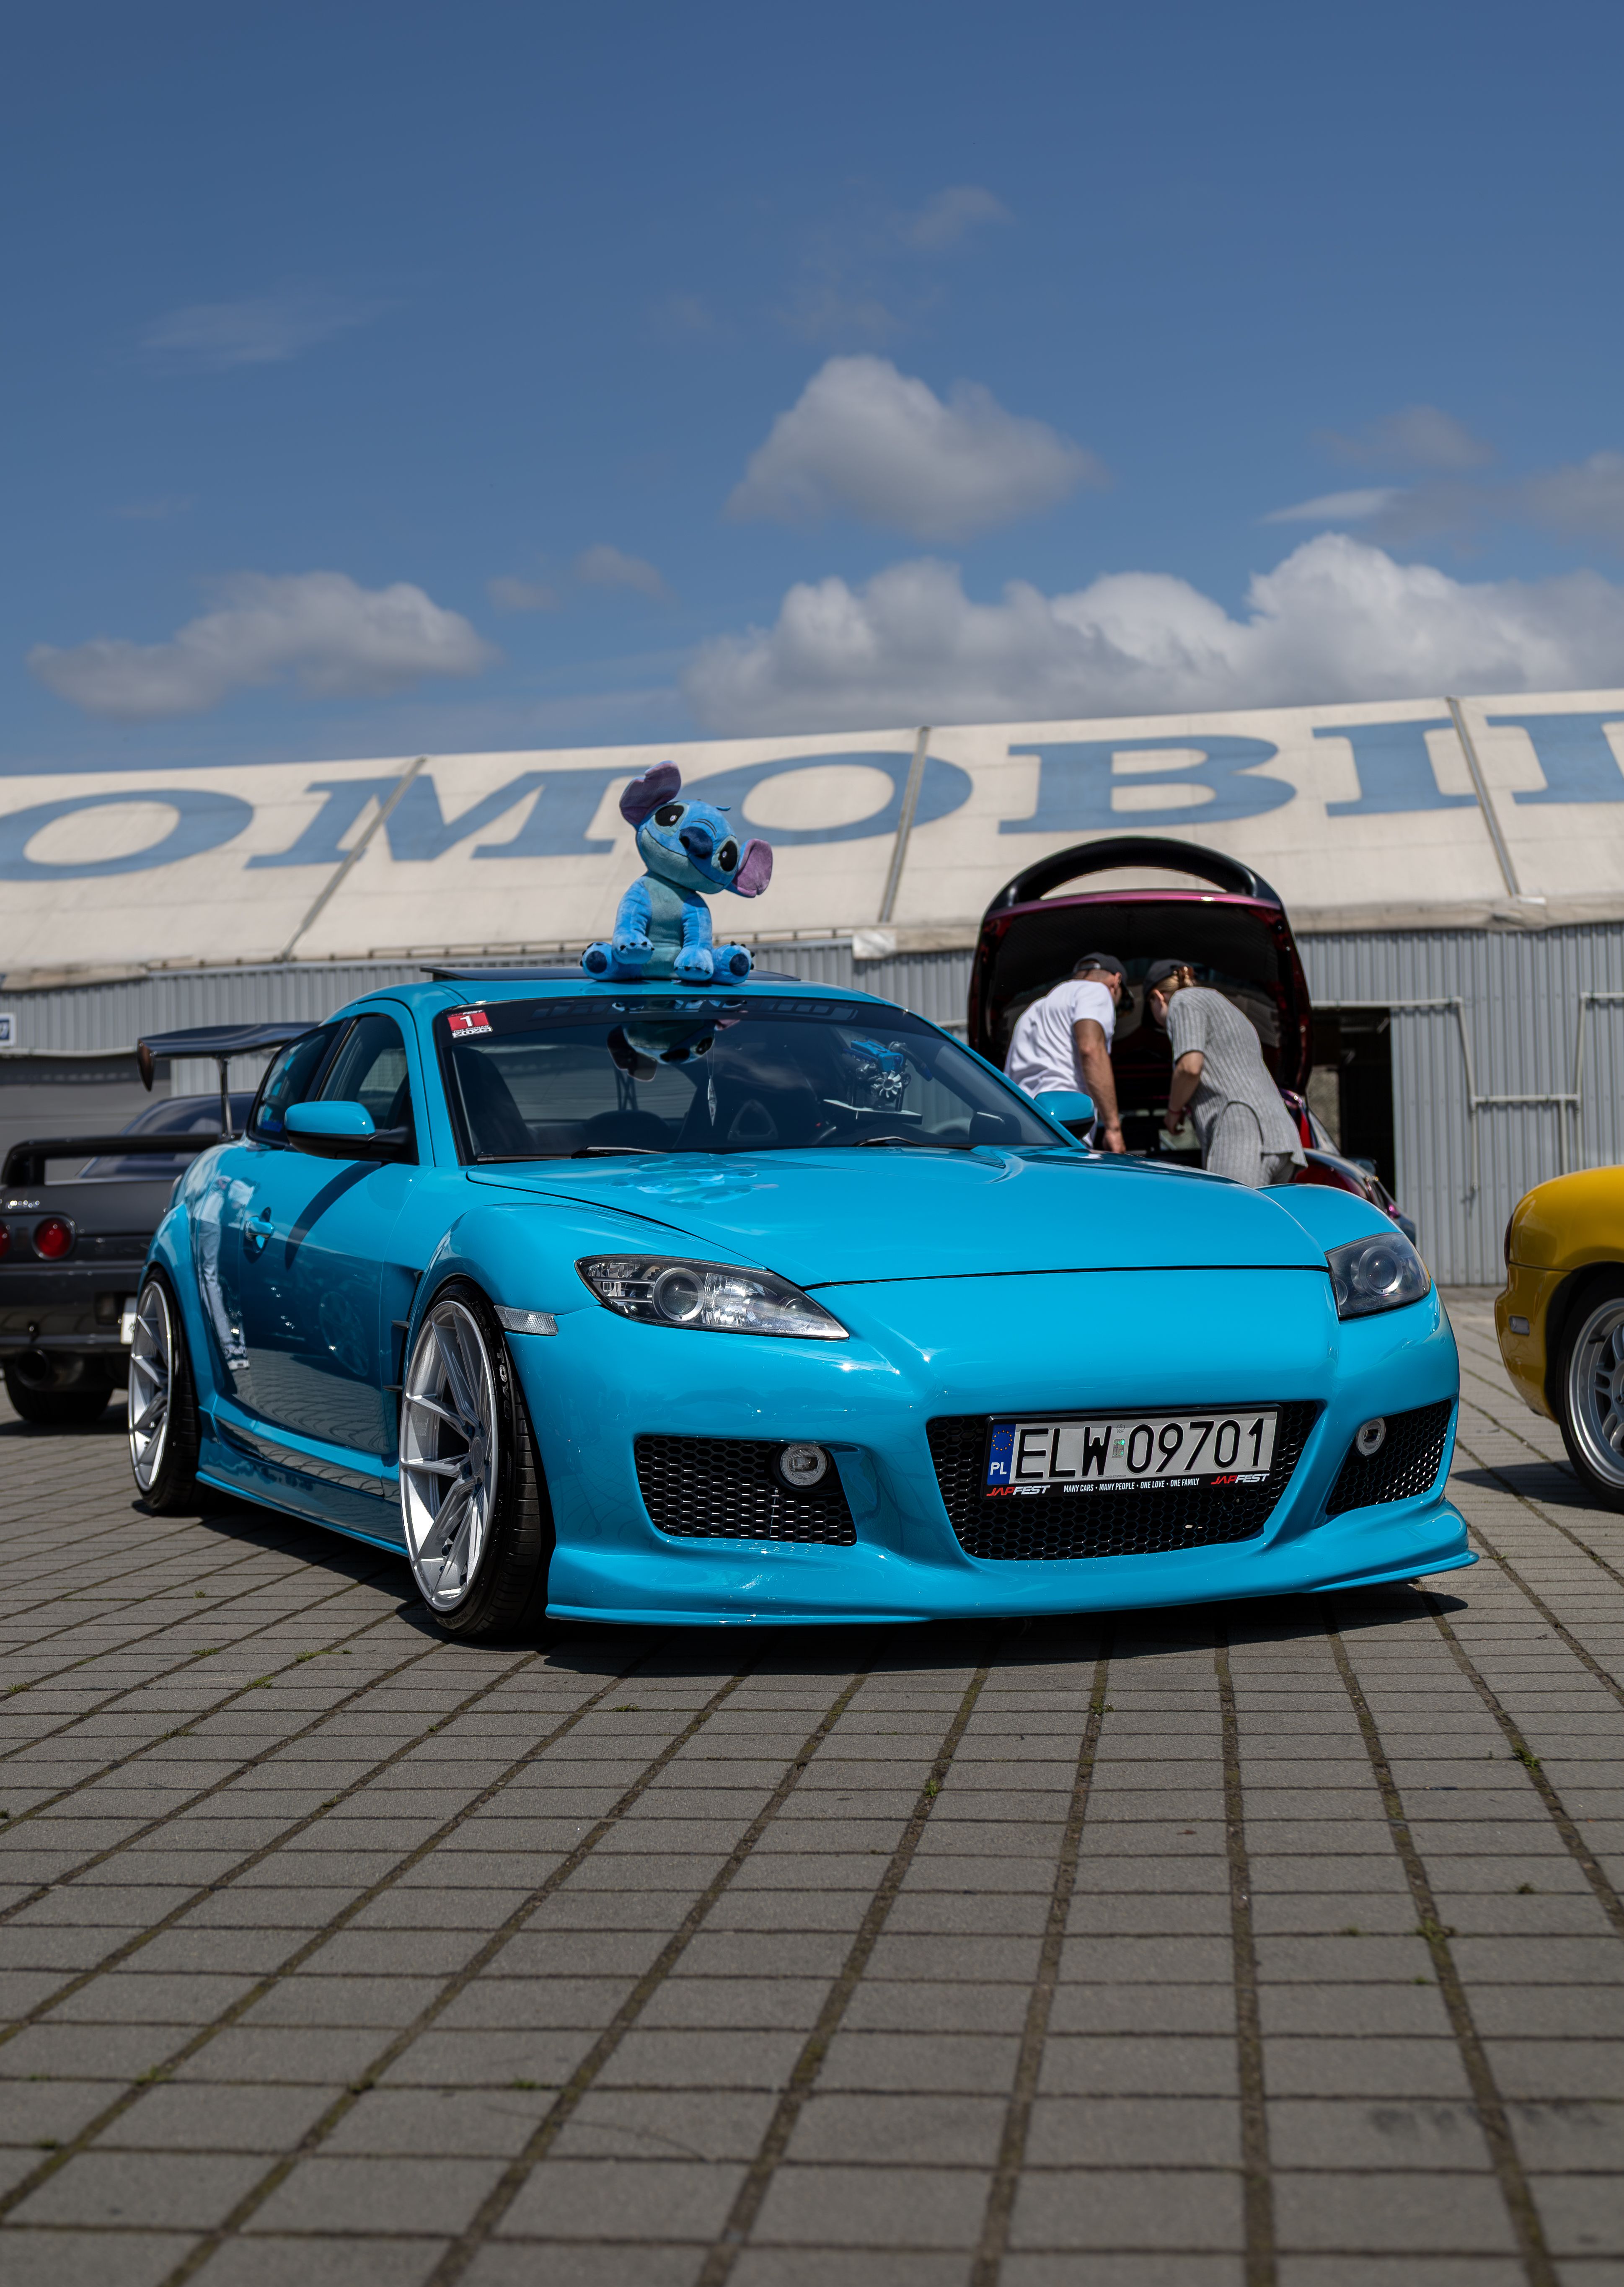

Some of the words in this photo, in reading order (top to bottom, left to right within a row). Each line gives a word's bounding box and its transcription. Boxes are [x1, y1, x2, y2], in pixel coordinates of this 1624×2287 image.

[460, 1015, 473, 1027] 1
[497, 1348, 511, 1420] TOYO
[1015, 1425, 1112, 1479] ELW
[1126, 1418, 1264, 1474] 09701
[990, 1462, 1007, 1475] PL
[1182, 1478, 1200, 1486] FAMILY
[1210, 1473, 1270, 1485] JAPFEST
[986, 1485, 1051, 1496] JAPFEST
